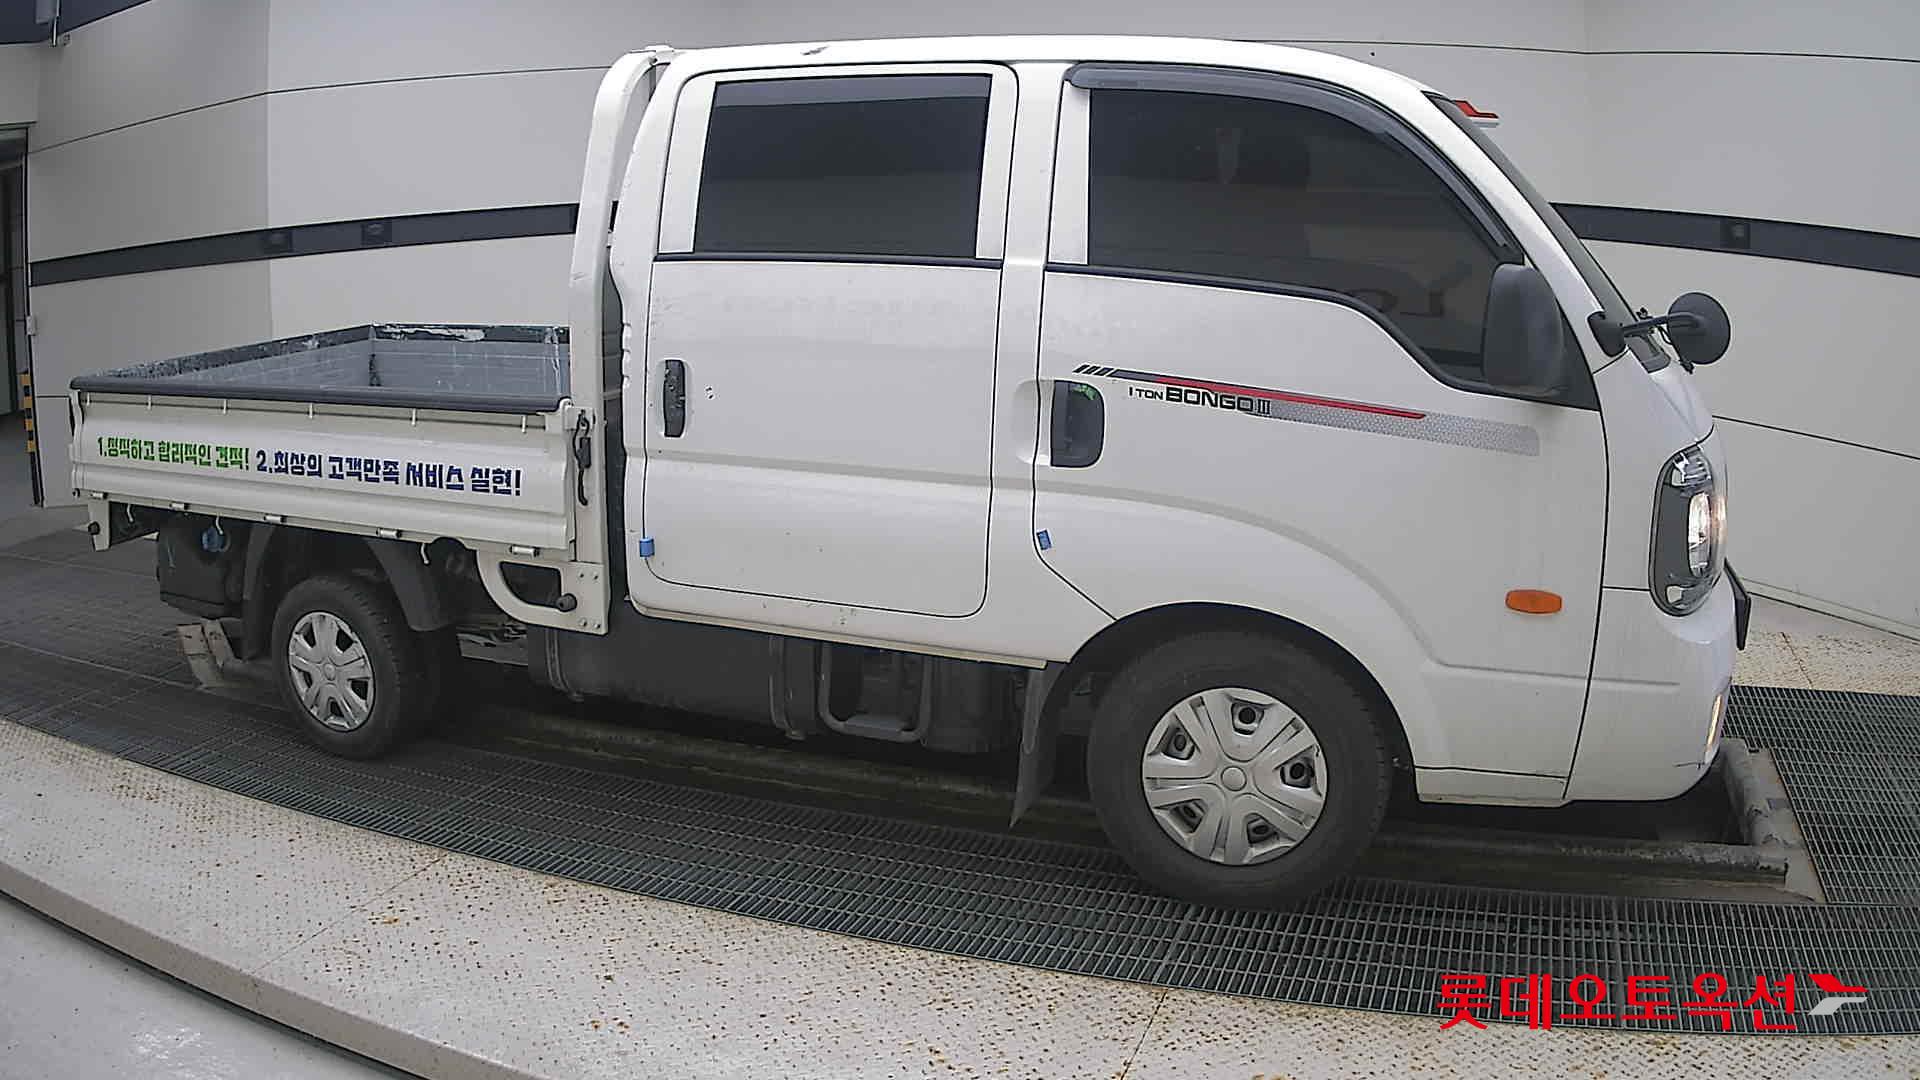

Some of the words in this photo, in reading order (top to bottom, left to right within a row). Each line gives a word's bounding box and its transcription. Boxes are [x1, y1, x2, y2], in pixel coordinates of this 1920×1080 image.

[1135, 388, 1164, 400] TON
[1165, 386, 1254, 413] BONGO
[256, 449, 323, 478] 2.최상의
[328, 455, 400, 485] 고객만족
[405, 462, 465, 491] 서비스
[470, 466, 521, 496] 실현!
